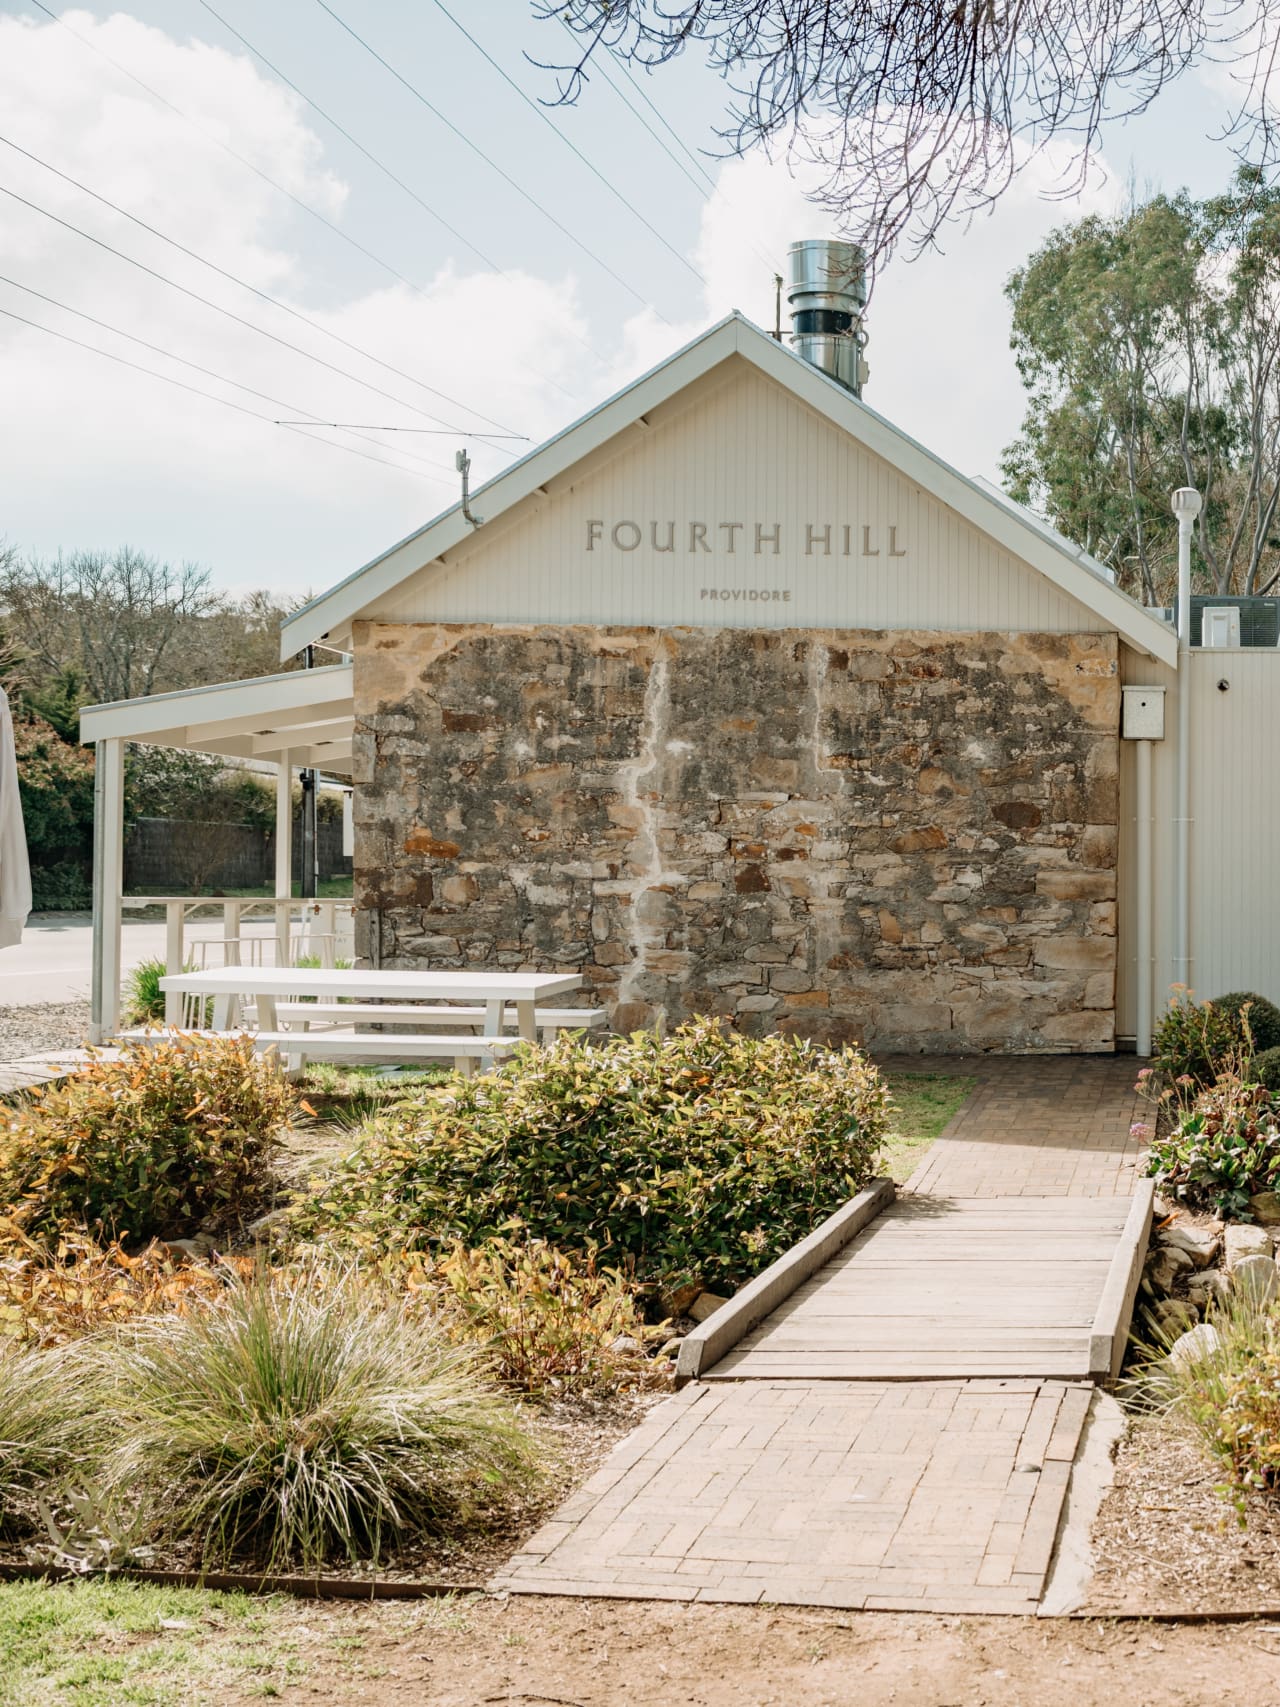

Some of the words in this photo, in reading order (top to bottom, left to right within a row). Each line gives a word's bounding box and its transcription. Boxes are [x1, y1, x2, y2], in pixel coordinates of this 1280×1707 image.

[586, 520, 781, 554] FOURTH
[805, 523, 906, 557] HILL
[701, 588, 791, 602] PROVIDORE
